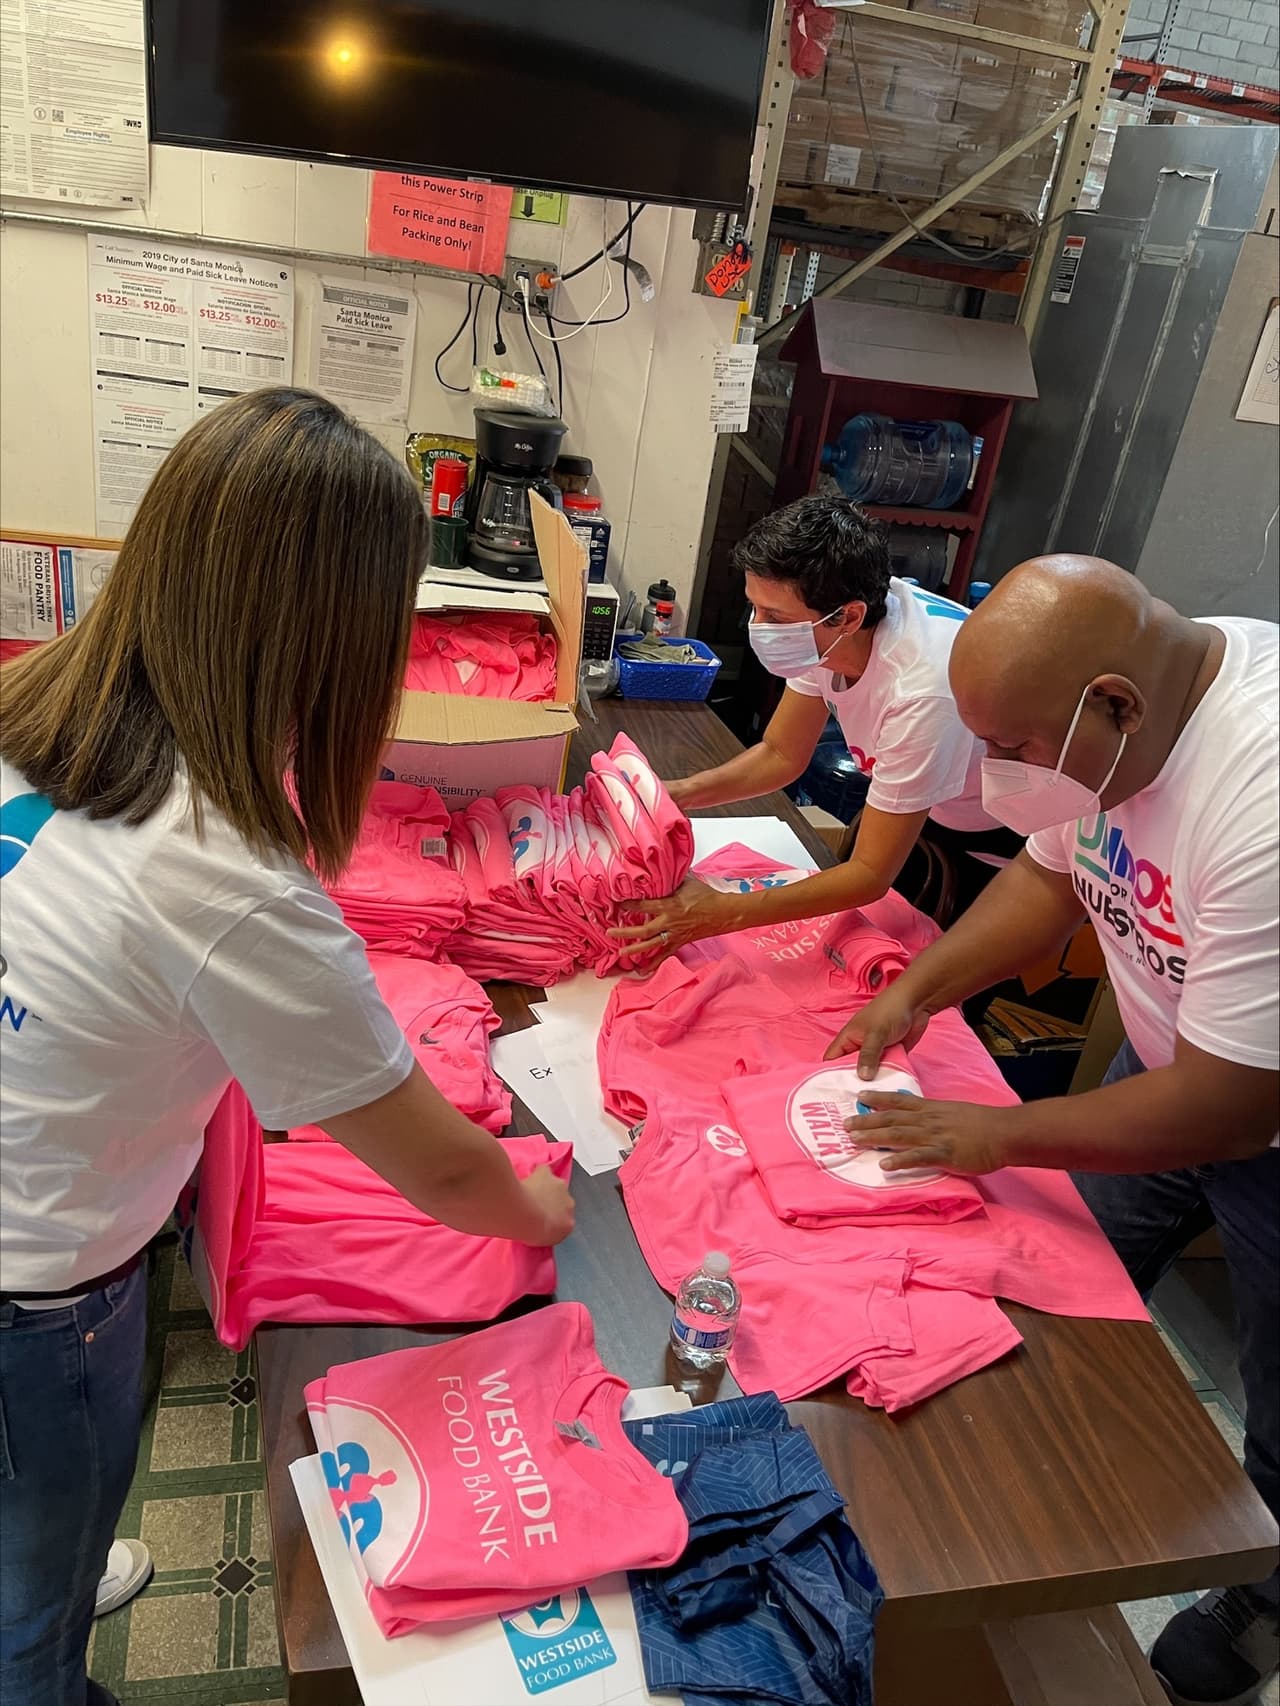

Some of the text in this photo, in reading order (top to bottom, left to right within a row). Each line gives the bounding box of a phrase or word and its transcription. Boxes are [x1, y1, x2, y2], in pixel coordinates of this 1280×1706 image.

[401, 175, 484, 204] this Power Strip
[392, 205, 484, 234] For Rice and Bean
[402, 227, 472, 252] Packing Only!
[106, 255, 278, 288] Minimum Wage and Paid Sick Leave Notices
[142, 250, 161, 260] 2019
[162, 254, 178, 264] City
[190, 258, 213, 268] Santa
[215, 262, 244, 273] Monica
[95, 293, 176, 313] $13.25 $12.00
[340, 308, 390, 322] Santa Monica
[200, 308, 231, 321] $13.25
[245, 315, 276, 328] $12.00
[336, 314, 352, 324] Paid
[354, 318, 369, 326] Sick
[372, 320, 393, 330] Leave
[43, 552, 51, 584] VETERAN
[34, 551, 46, 622] FOOD PANTRY
[400, 774, 448, 786] GENUINE
[434, 786, 482, 797] NSIBILITY
[750, 920, 800, 950] BANK
[800, 1102, 842, 1157] WALK
[437, 1375, 510, 1564] FOOD BANK
[477, 1368, 558, 1548] WESTSIDE
[519, 1629, 605, 1671] WESTSIDE
[526, 1647, 614, 1688] FOOD BANK
